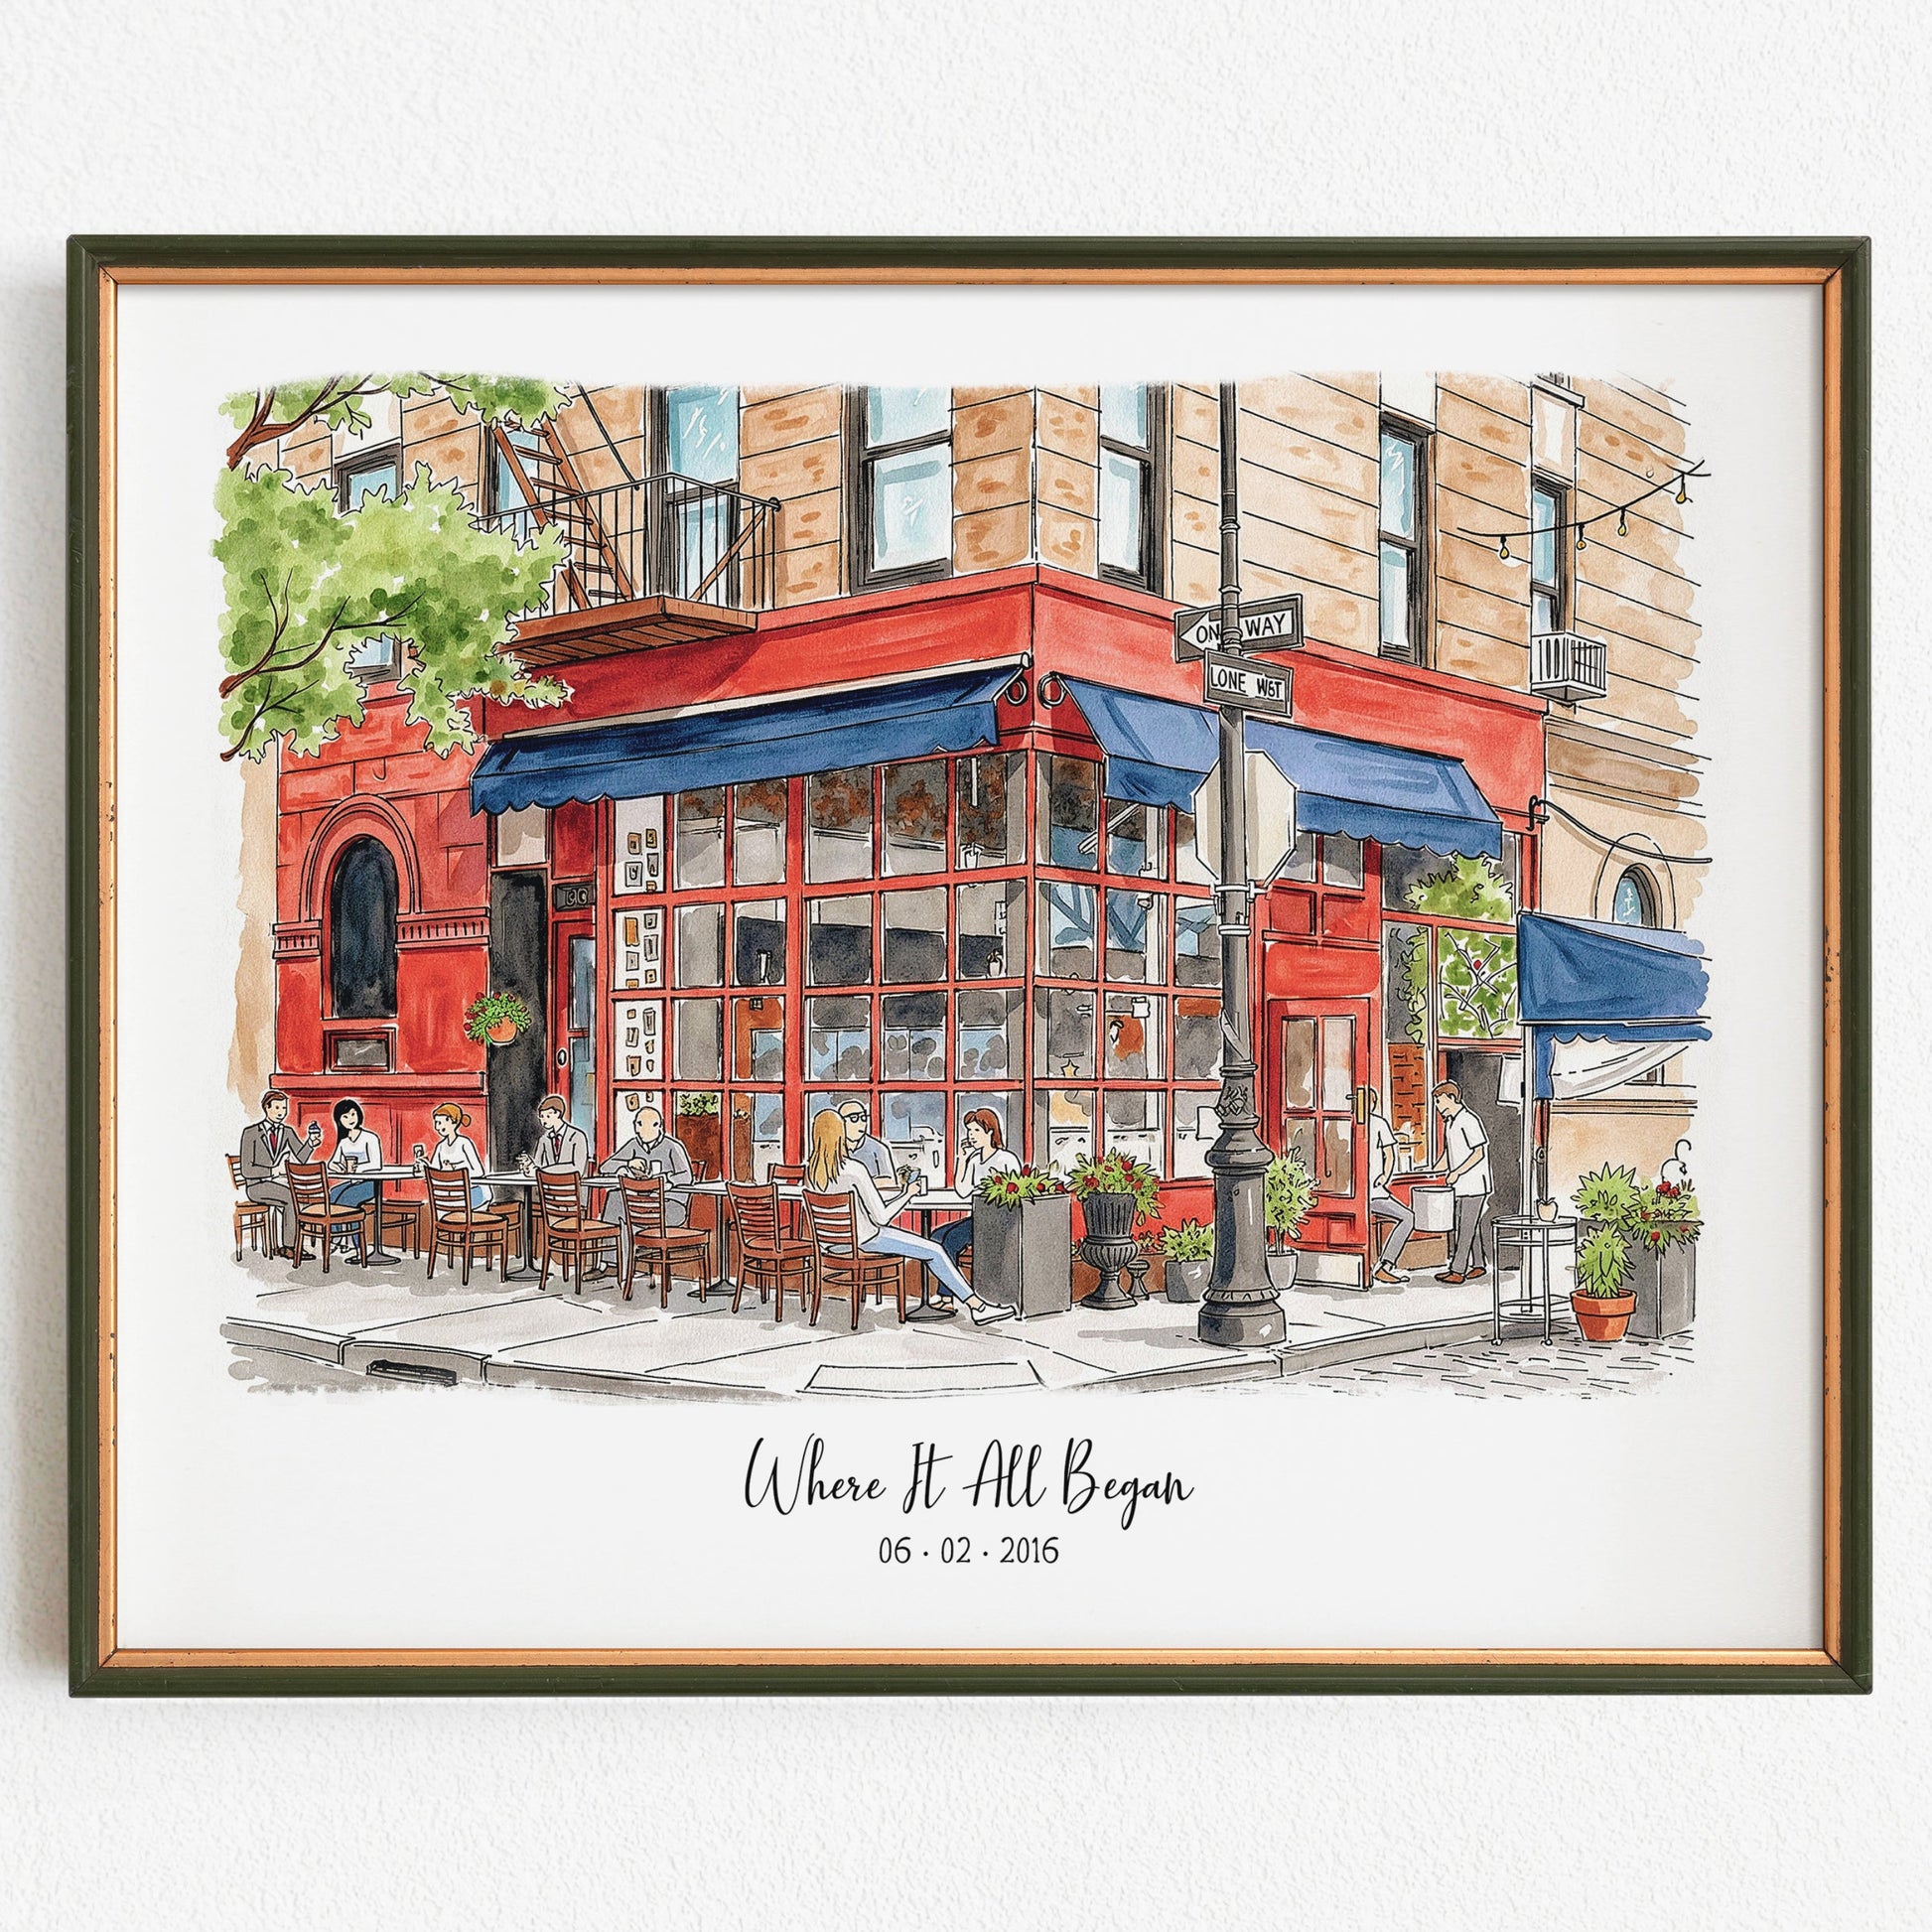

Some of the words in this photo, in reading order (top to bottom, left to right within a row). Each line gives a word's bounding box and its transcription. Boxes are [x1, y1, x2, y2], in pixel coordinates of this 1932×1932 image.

[1195, 623, 1222, 643] ON
[1244, 613, 1286, 637] WAY
[1210, 666, 1247, 693] LONE
[744, 1433, 888, 1516] Where
[901, 1441, 954, 1515] It
[962, 1439, 1047, 1509] All
[1062, 1437, 1195, 1531] Began
[999, 1536, 1059, 1565] 2016
